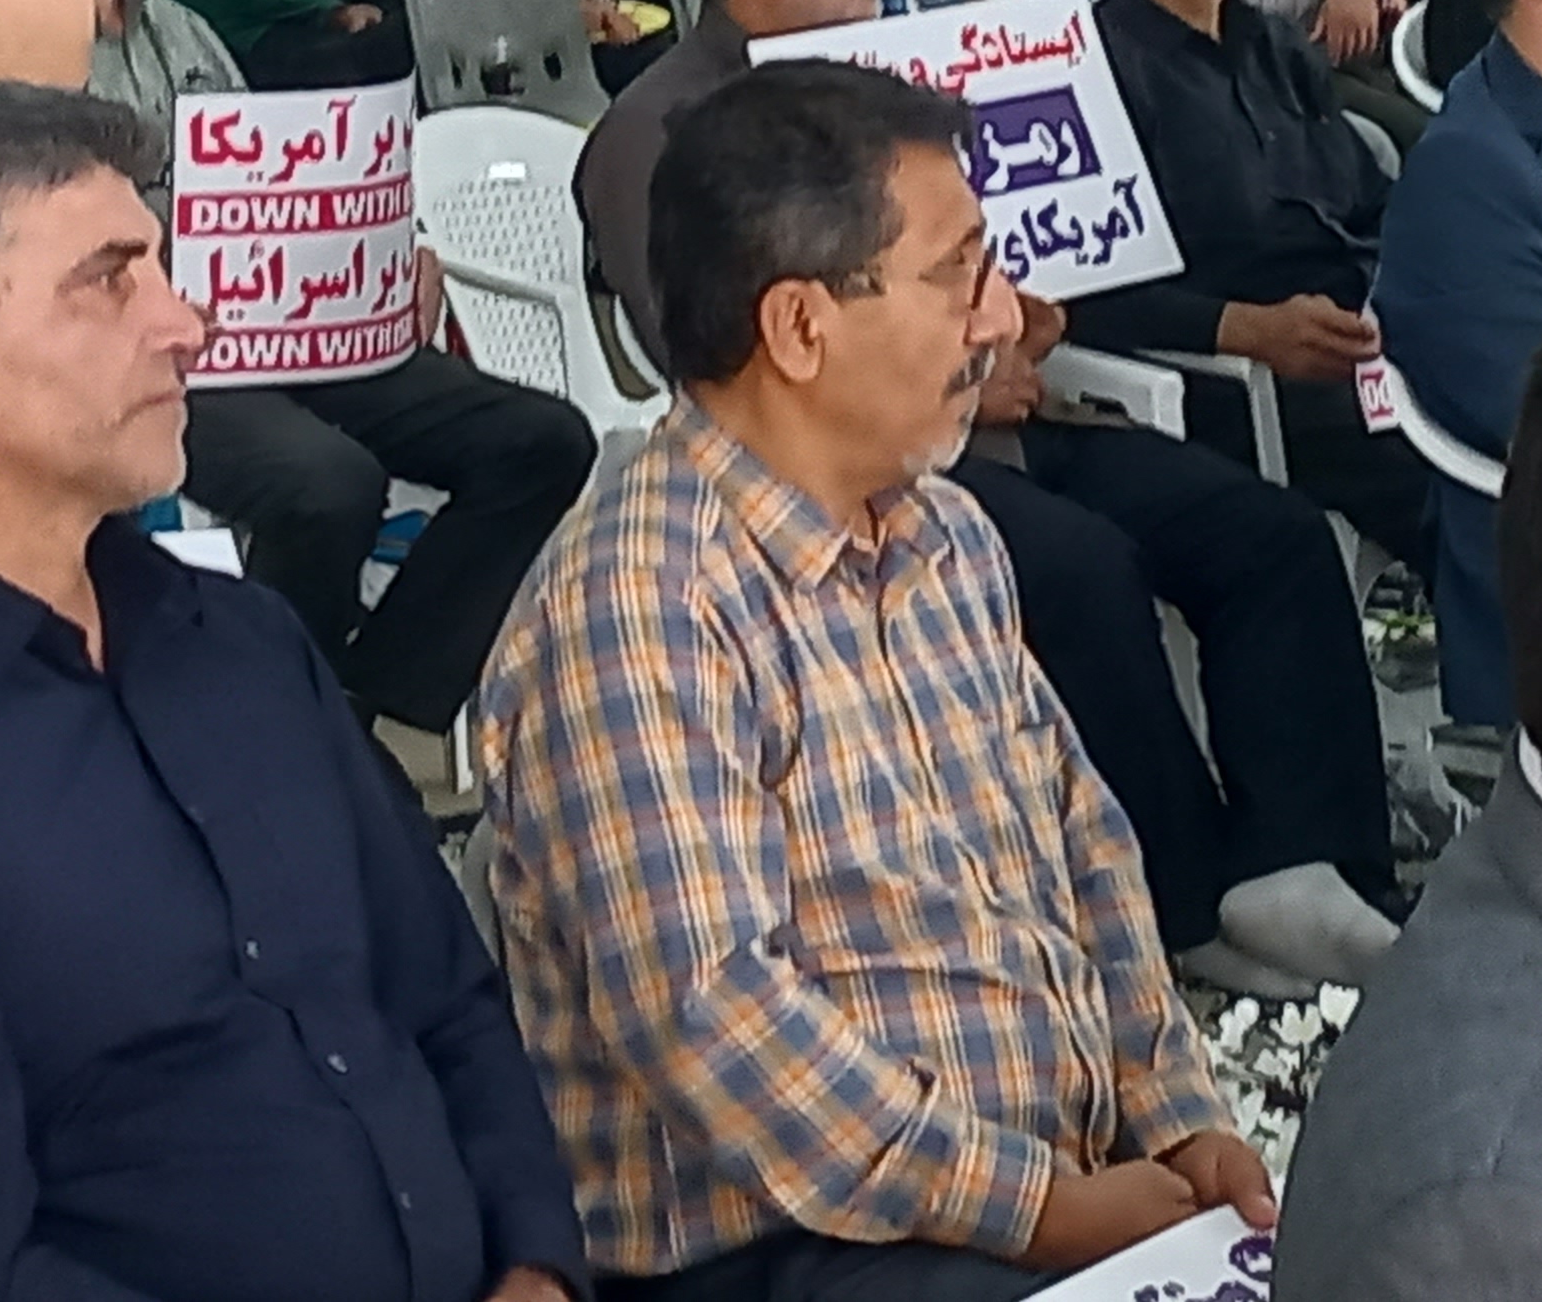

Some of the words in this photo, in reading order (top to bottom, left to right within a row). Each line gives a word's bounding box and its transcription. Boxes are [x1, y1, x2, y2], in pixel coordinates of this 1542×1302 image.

[189, 94, 358, 185] آمریکا
[981, 120, 1082, 191] رمز
[190, 194, 320, 232] DOWN
[1003, 173, 1145, 285] آمریکای
